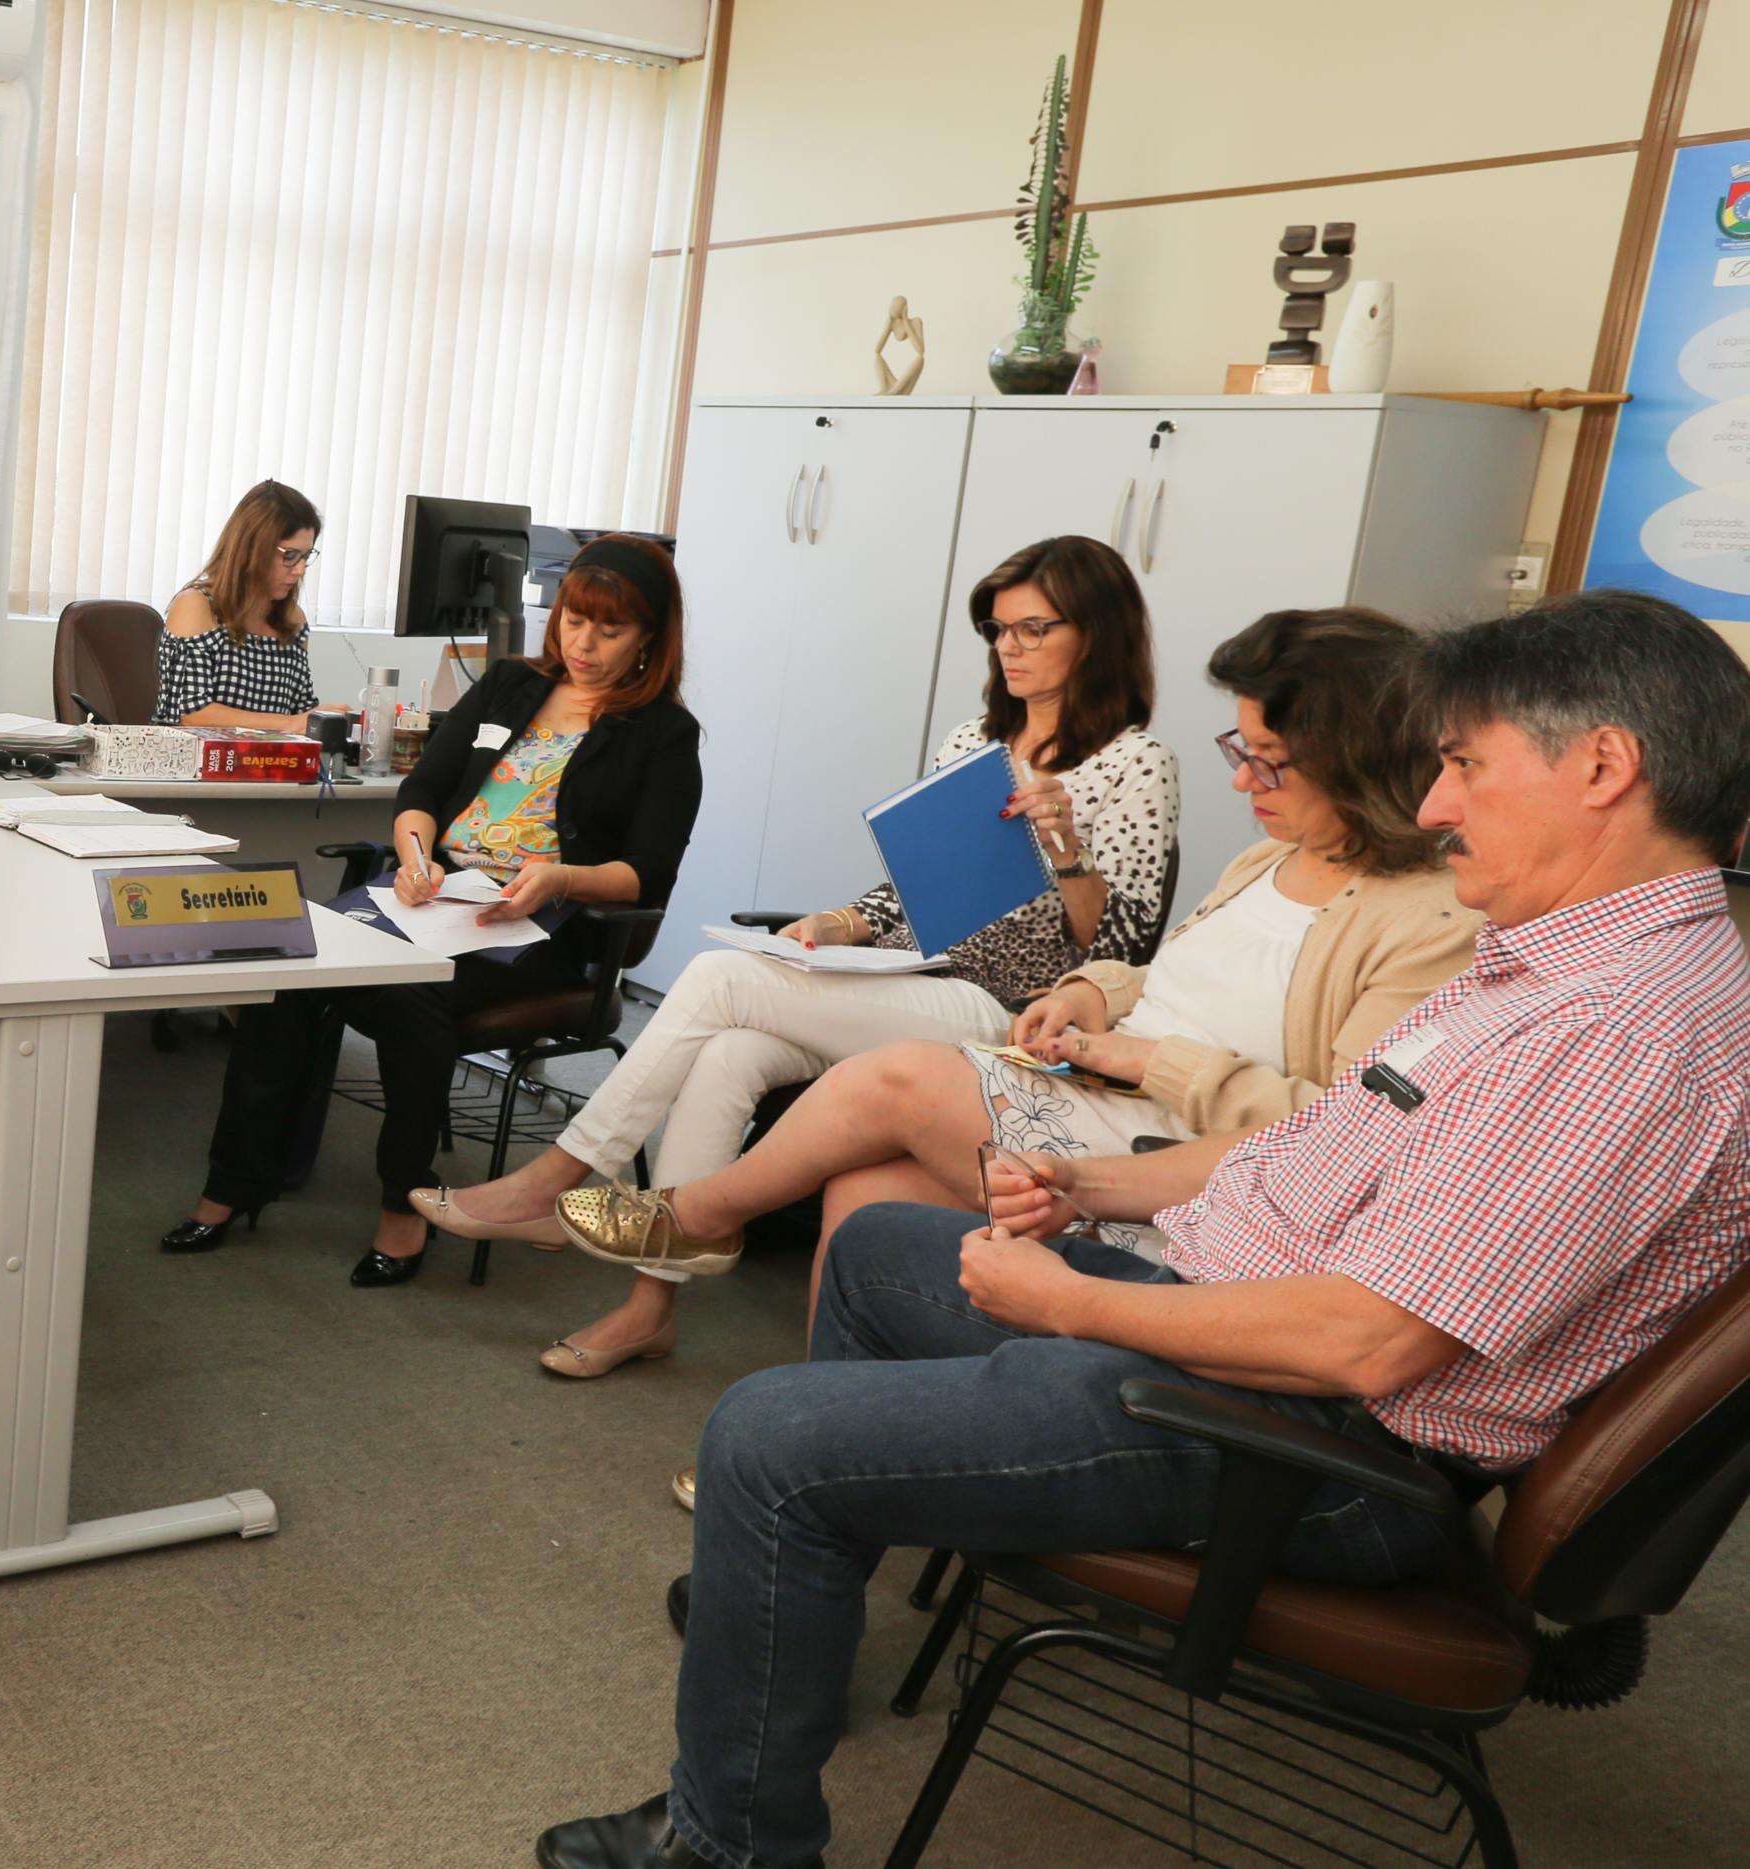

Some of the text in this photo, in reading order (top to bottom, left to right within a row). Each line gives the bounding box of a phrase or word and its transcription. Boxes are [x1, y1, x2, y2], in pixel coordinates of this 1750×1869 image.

[365, 693, 380, 762] VOSS
[208, 749, 216, 772] VADE
[226, 749, 235, 772] 2016
[242, 756, 299, 769] Saraiva
[180, 884, 268, 910] Secretário
